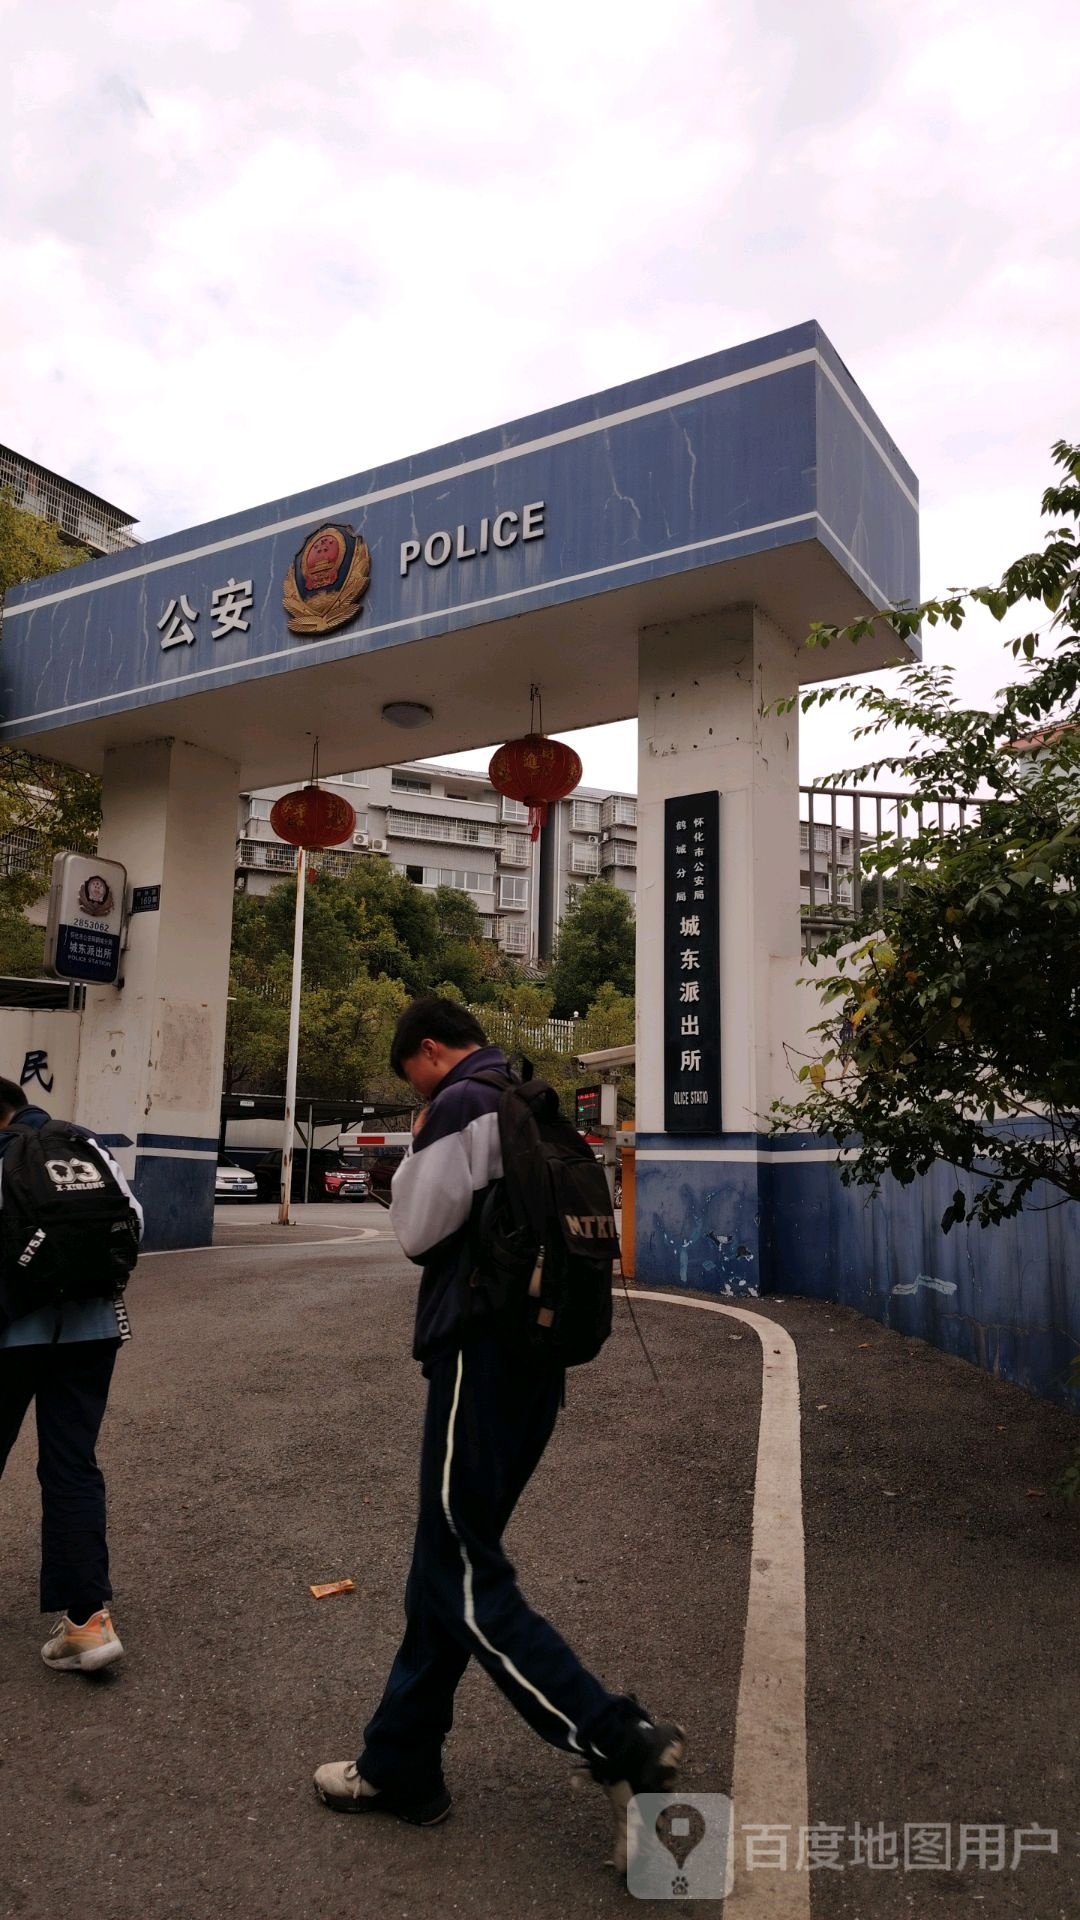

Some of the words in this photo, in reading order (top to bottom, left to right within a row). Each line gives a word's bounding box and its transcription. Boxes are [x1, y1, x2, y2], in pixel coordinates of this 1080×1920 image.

[400, 500, 545, 576] POLICE
[157, 577, 254, 651] 公安
[675, 820, 688, 902] 鹤城分局
[693, 817, 705, 900] 怀化市公安局
[73, 917, 110, 932] 2853062
[679, 914, 701, 1072] 城东派出所
[20, 1050, 54, 1093] 民
